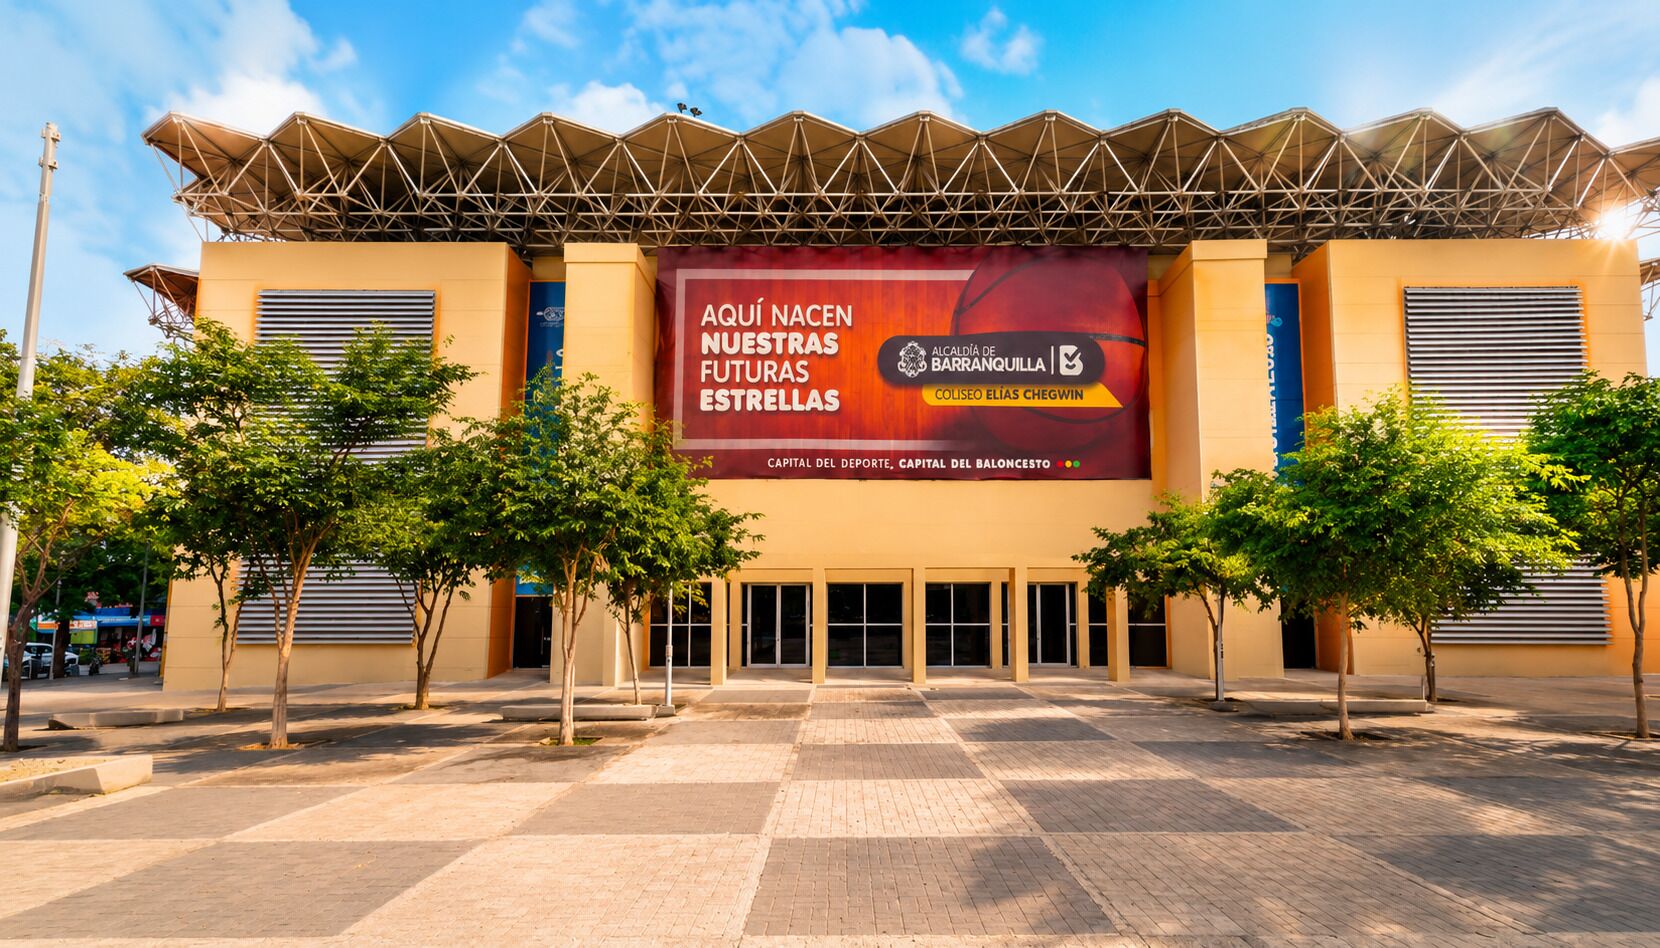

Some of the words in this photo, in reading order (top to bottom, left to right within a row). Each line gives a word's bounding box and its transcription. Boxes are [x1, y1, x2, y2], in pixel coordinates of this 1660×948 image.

[701, 297, 764, 327] AQUÍ
[772, 304, 852, 326] NACEN
[701, 332, 839, 355] NUESTRAS
[982, 346, 996, 357] DE
[701, 360, 809, 383] FUTURAS
[932, 357, 1045, 372] BARRANQUILLA
[700, 388, 840, 411] ESTRELLAS
[935, 388, 983, 401] COLISEO
[986, 385, 1019, 400] ELÍAS
[1023, 388, 1084, 401] CHEGWIN
[767, 457, 812, 468] CAPITAL
[815, 458, 837, 468] DEL
[841, 458, 894, 470] DEPORTE,
[899, 458, 947, 469] CAPITAL
[951, 459, 972, 469] DEL
[976, 458, 1051, 469] BALONCESTO
